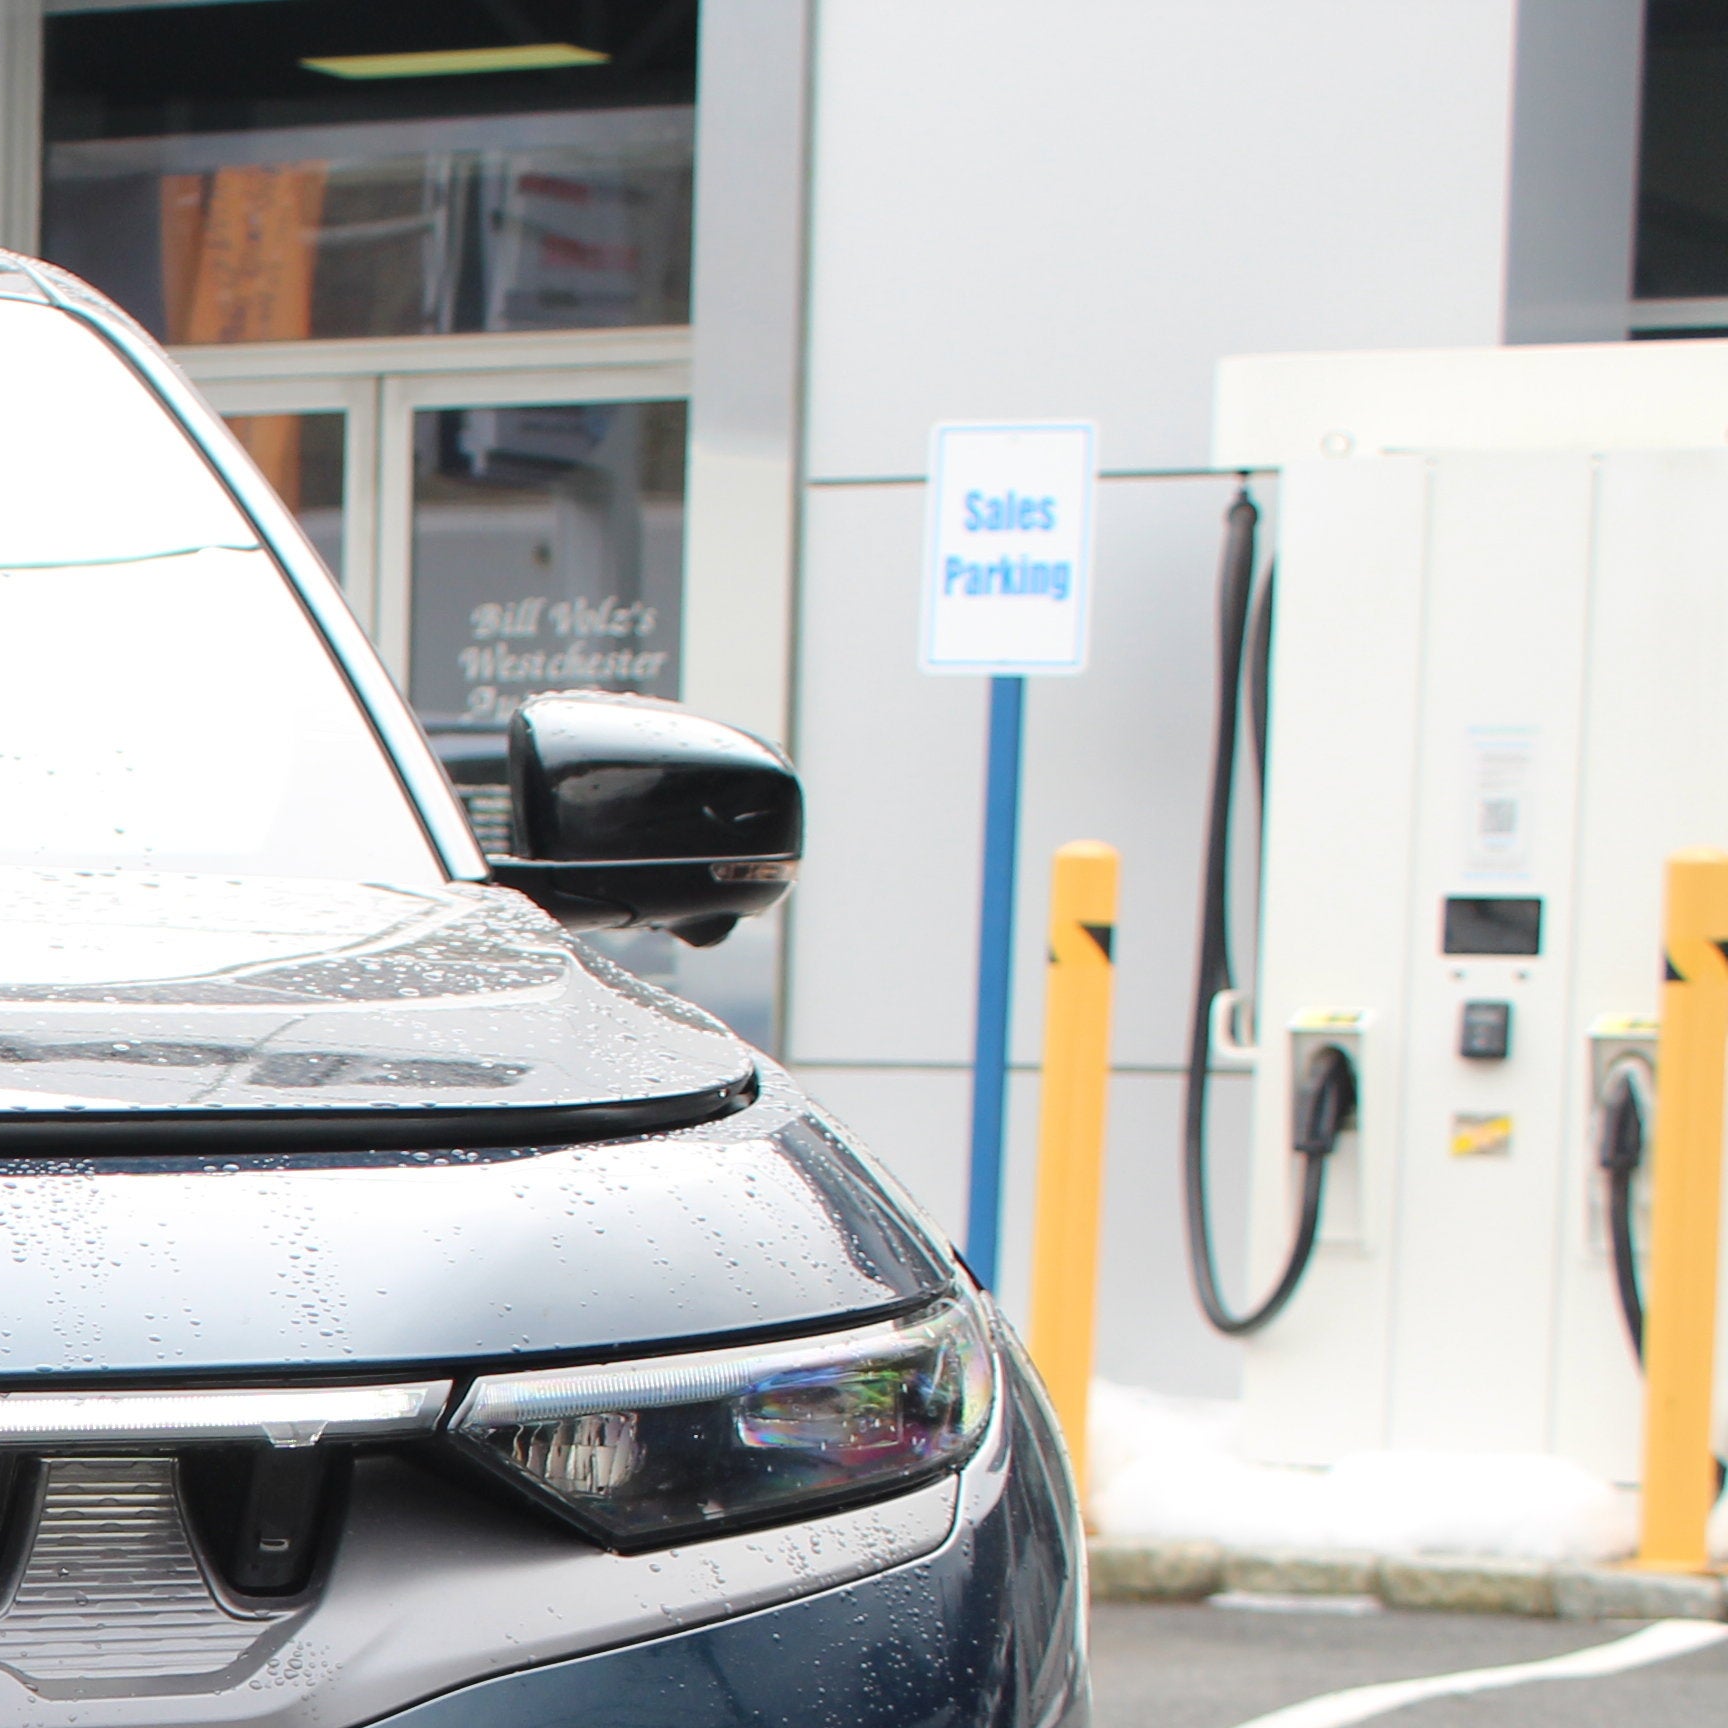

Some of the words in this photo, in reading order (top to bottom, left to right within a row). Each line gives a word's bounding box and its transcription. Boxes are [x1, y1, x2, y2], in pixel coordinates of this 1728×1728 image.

[964, 488, 1056, 532] Sales
[945, 554, 1072, 602] Parking
[469, 596, 546, 639] Bill
[548, 595, 658, 637] Volz's
[458, 641, 668, 683] Westchester
